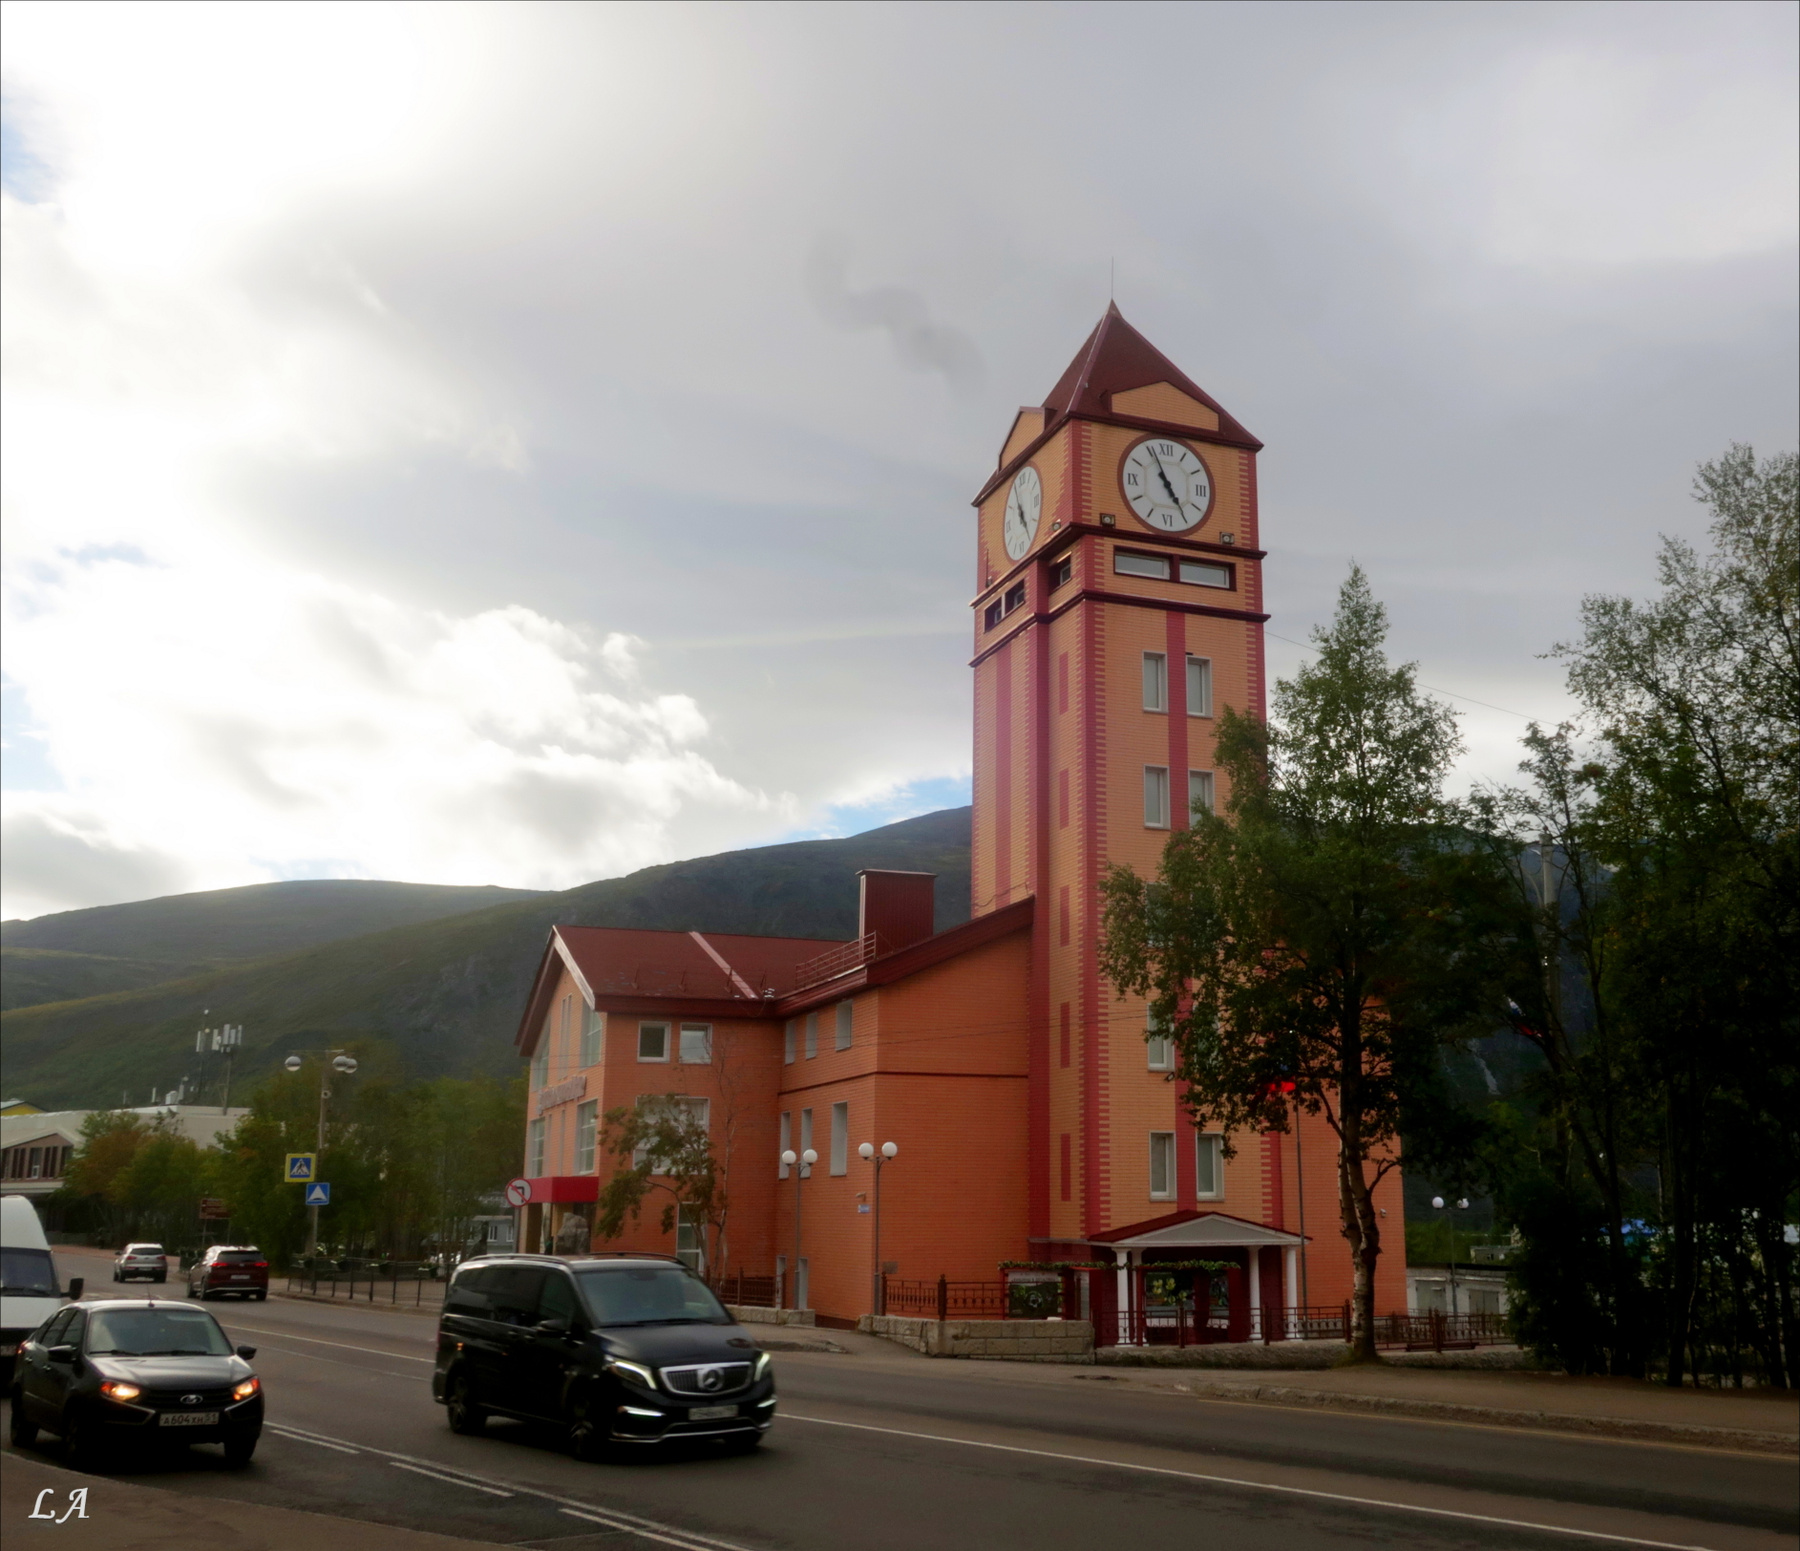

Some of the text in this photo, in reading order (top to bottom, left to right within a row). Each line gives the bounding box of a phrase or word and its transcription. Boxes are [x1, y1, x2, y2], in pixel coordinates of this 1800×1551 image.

[1159, 443, 1174, 457] XII
[1127, 472, 1139, 486] IX
[1195, 484, 1207, 498] III
[1161, 513, 1173, 527] VI
